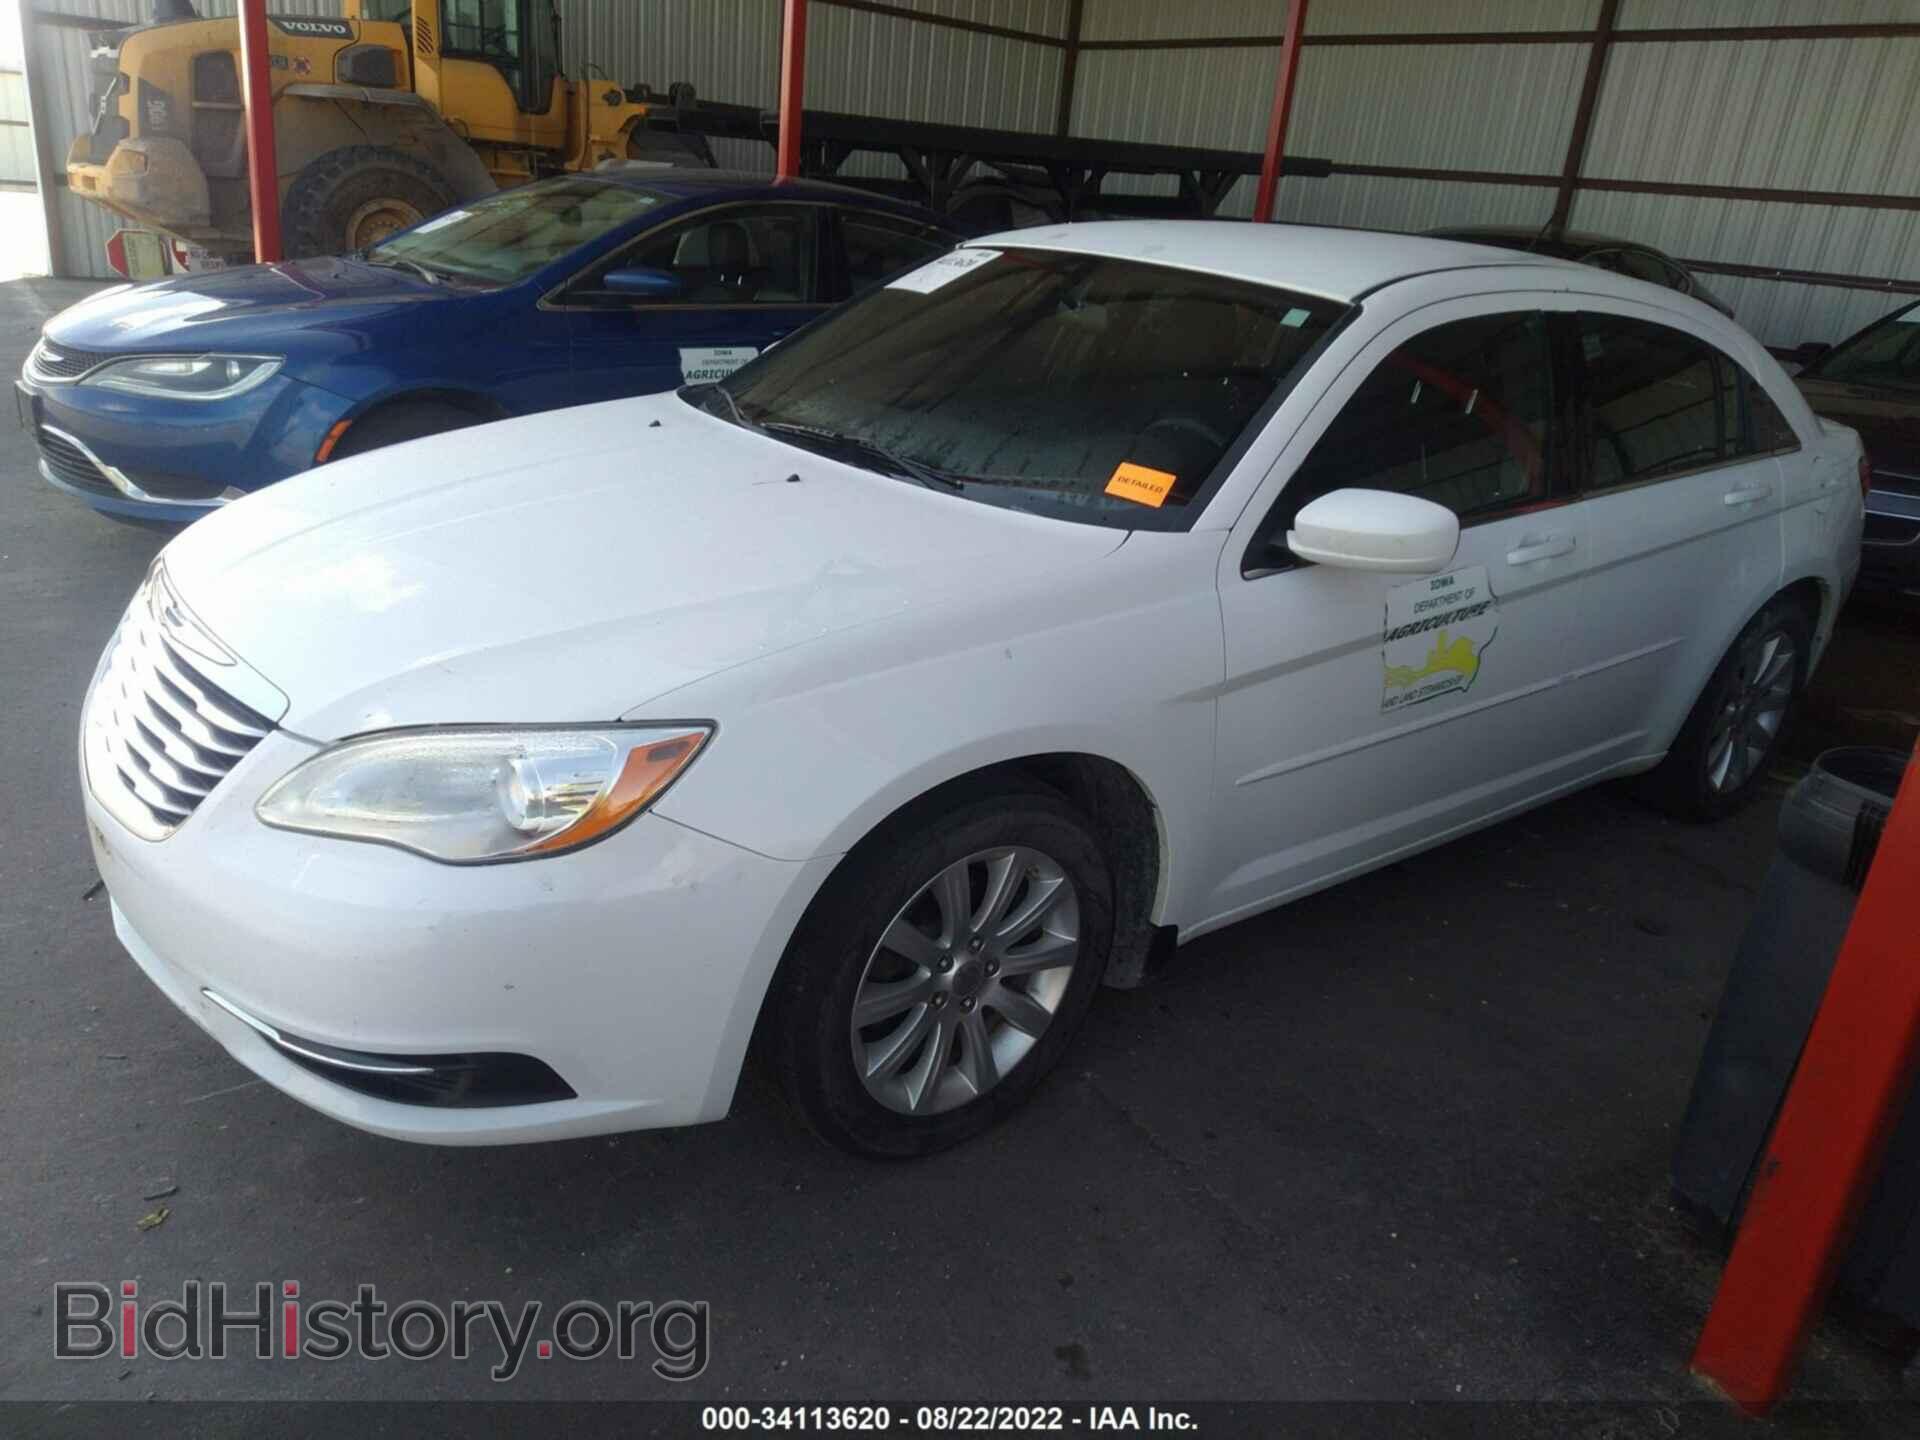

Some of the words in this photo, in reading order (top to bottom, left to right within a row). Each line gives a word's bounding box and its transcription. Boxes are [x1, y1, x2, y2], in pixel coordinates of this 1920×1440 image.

[280, 20, 347, 34] VOLVO
[1118, 476, 1164, 494] DETAILED
[1430, 575, 1454, 590] IOWA
[1413, 590, 1464, 614] DEPARTMENT
[1463, 586, 1476, 600] OF
[1384, 600, 1492, 642] AGRICULTURE
